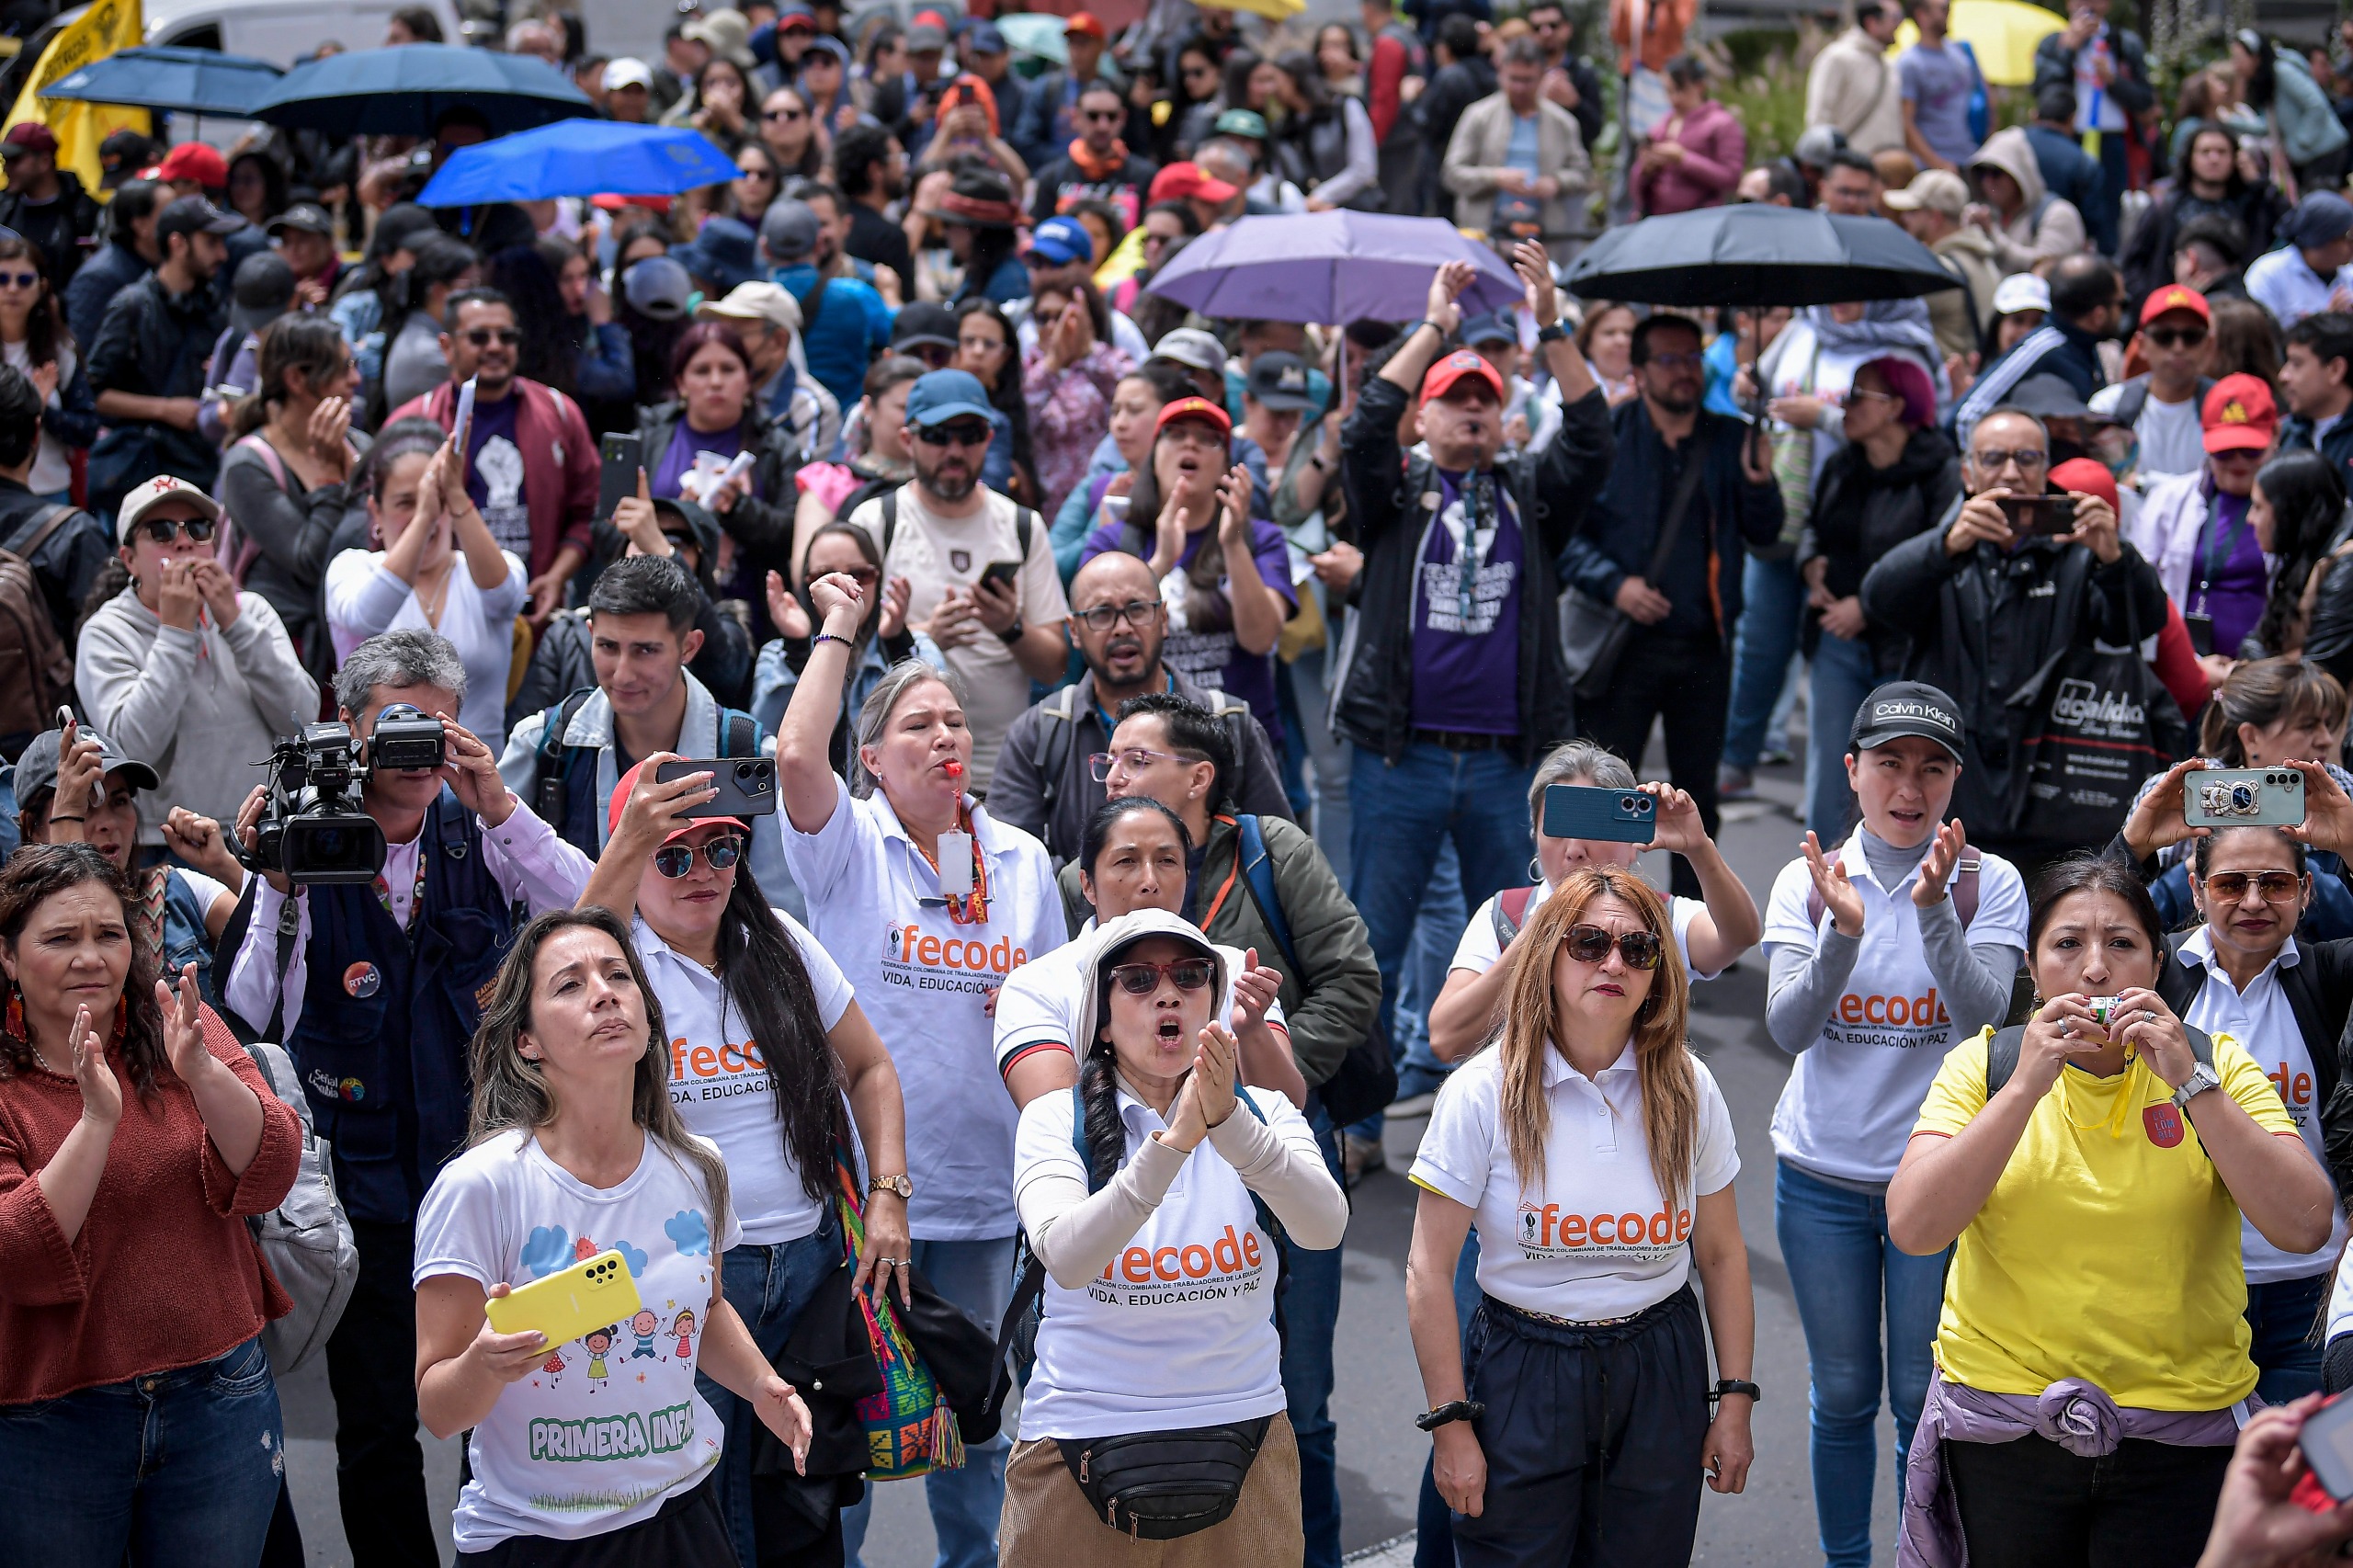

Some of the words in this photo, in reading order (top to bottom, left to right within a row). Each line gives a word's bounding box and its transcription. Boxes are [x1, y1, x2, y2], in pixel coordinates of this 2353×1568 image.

[1876, 702, 1923, 715] Calvin
[1926, 704, 1956, 729] Klein
[902, 925, 1027, 973] fecode
[348, 972, 376, 988] RTVC
[881, 960, 912, 971] FEDERACIÓN
[913, 967, 946, 975] COLOMBIANA
[955, 971, 993, 980] TRABAJADORES
[882, 971, 915, 989] VIDA,
[474, 977, 498, 999] RADIO
[1847, 1033, 1917, 1049] EDUCACIÓN
[1920, 1036, 1927, 1046] Y
[1927, 1032, 1948, 1045] PAZ
[314, 1068, 338, 1088] Señal
[690, 1075, 730, 1085] COLOMBIANA
[1541, 1200, 1691, 1247] fecode
[1518, 1243, 1554, 1252] FEDERACIÓN
[1086, 1285, 1123, 1306] VIDA,
[1129, 1286, 1227, 1305] EDUCACIÓN
[1233, 1284, 1241, 1297] Y
[1243, 1277, 1260, 1296] PAZ
[1173, 1278, 1224, 1288] TRABAJADORES
[530, 1413, 649, 1460] PRIMERA
